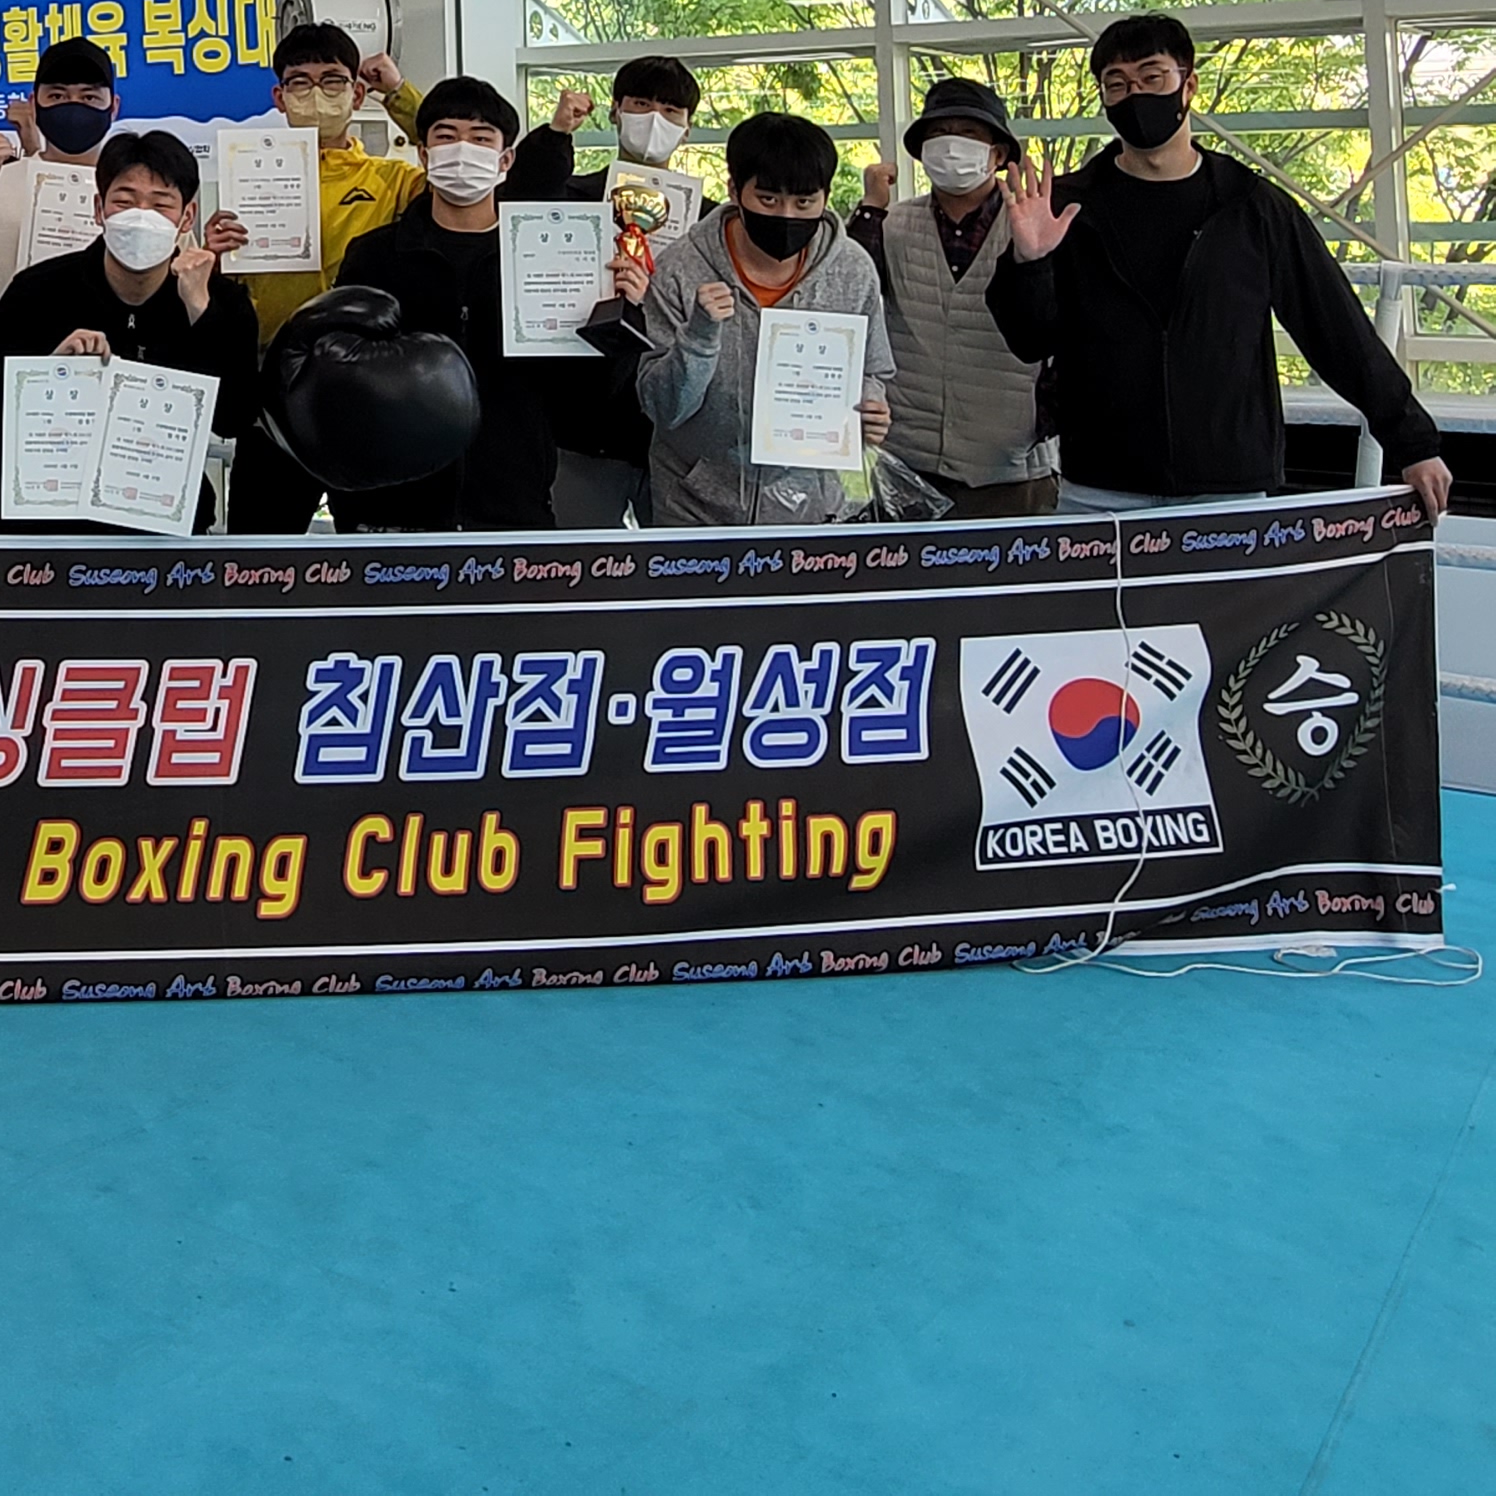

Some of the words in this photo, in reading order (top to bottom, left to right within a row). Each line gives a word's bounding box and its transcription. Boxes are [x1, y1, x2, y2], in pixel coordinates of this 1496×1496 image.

[6, 562, 55, 585] Club
[68, 564, 157, 594] Suseong
[166, 561, 215, 589] Art
[223, 562, 295, 593] Boxing
[304, 561, 351, 584] Club
[363, 562, 450, 590] Suseong
[457, 557, 505, 585] Art
[513, 557, 582, 587] Boxing
[591, 555, 636, 578] Club
[648, 555, 731, 583] Suseong
[737, 549, 784, 577] Art
[791, 549, 857, 579] Boxing
[866, 545, 908, 568] Club
[921, 543, 1000, 572] Suseong
[1007, 538, 1052, 566] Art
[1130, 530, 1172, 555] Club
[1182, 528, 1258, 556] Suseong
[1263, 519, 1307, 548] Art
[1312, 514, 1375, 542] Boxing
[1262, 654, 1360, 757] 승
[19, 817, 308, 919] Boxing
[343, 811, 519, 897] Club
[558, 798, 896, 905] Fighting
[986, 822, 1090, 860] KOREA
[1094, 810, 1210, 851] BOXING
[1266, 891, 1310, 917] Art
[1316, 891, 1384, 919] Boxing
[1395, 891, 1435, 914] Club
